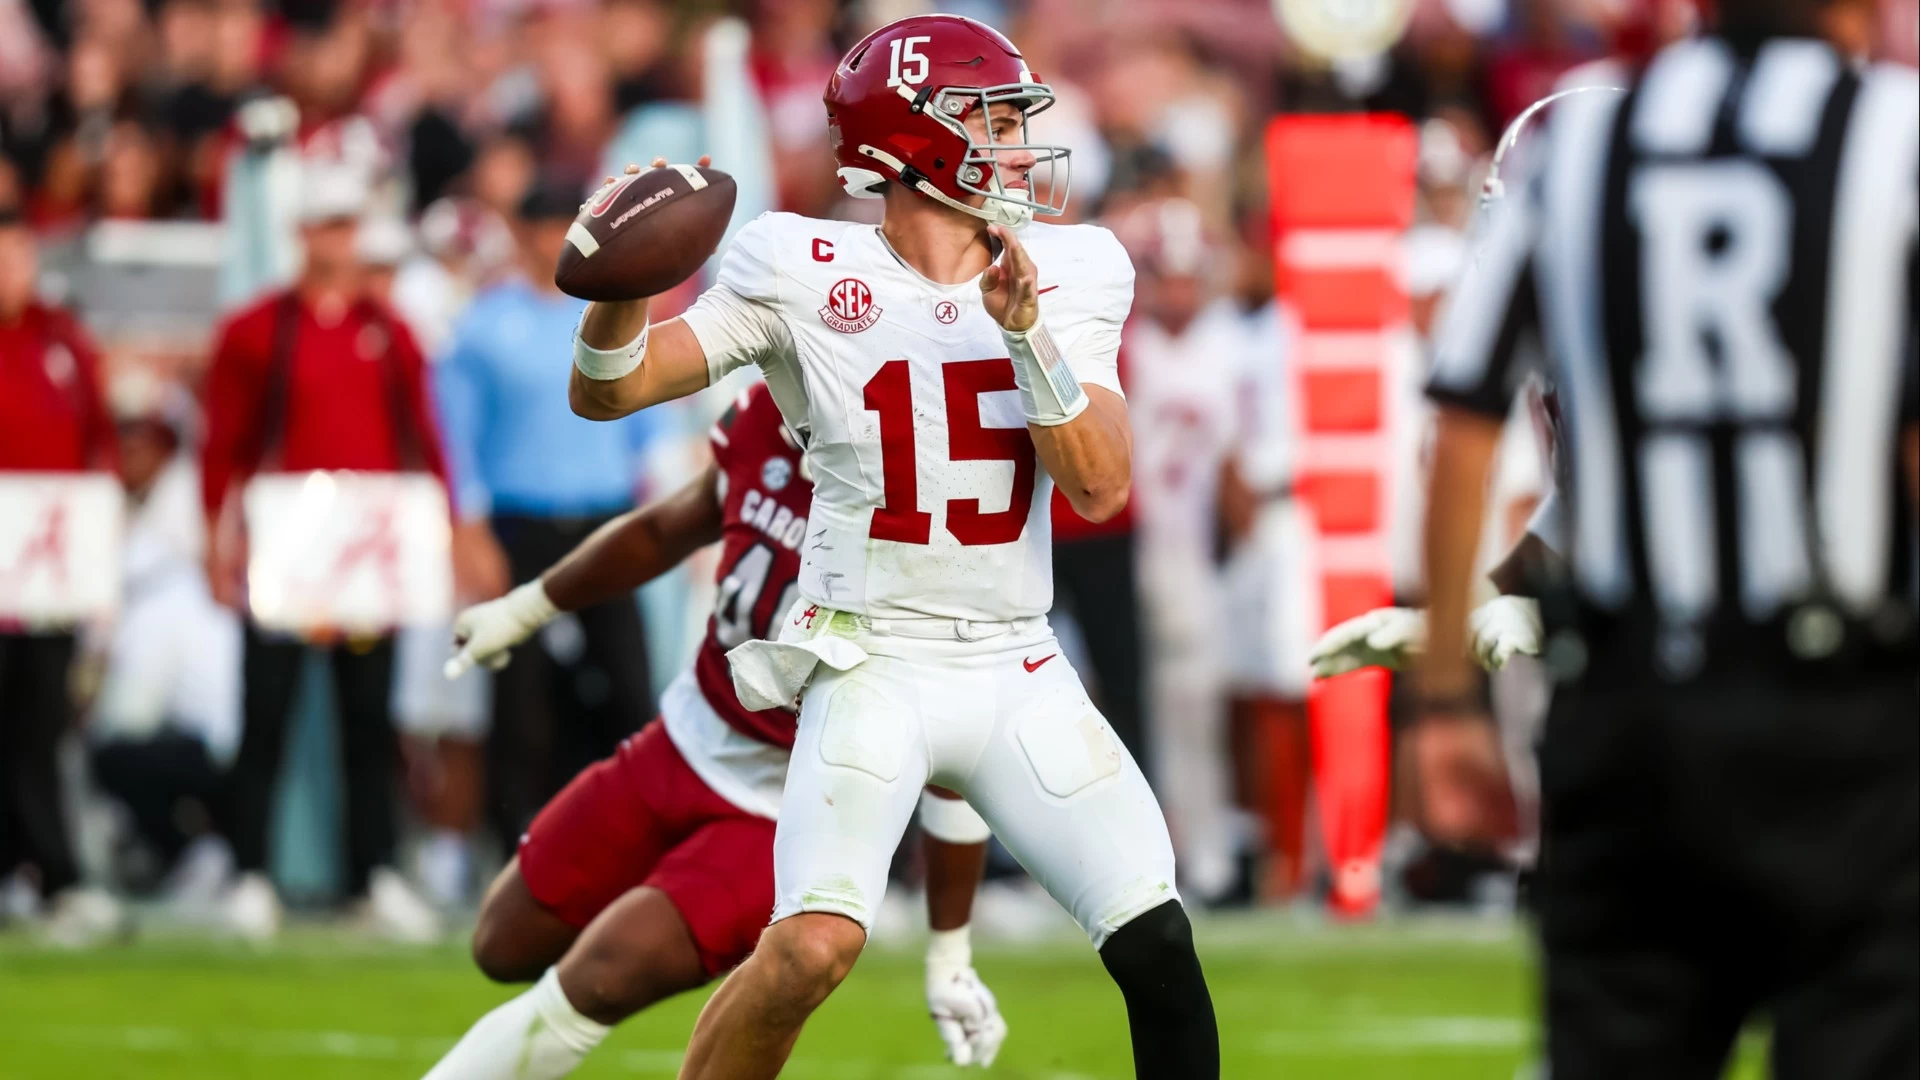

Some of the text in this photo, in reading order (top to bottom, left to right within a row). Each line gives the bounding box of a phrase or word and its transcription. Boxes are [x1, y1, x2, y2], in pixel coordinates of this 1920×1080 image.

[886, 35, 931, 88] 15
[812, 237, 834, 262] C
[831, 280, 870, 319] SEC
[1627, 157, 1798, 417] R
[826, 315, 875, 332] GRADUATE
[863, 357, 1036, 546] 15
[740, 489, 808, 556] CARO
